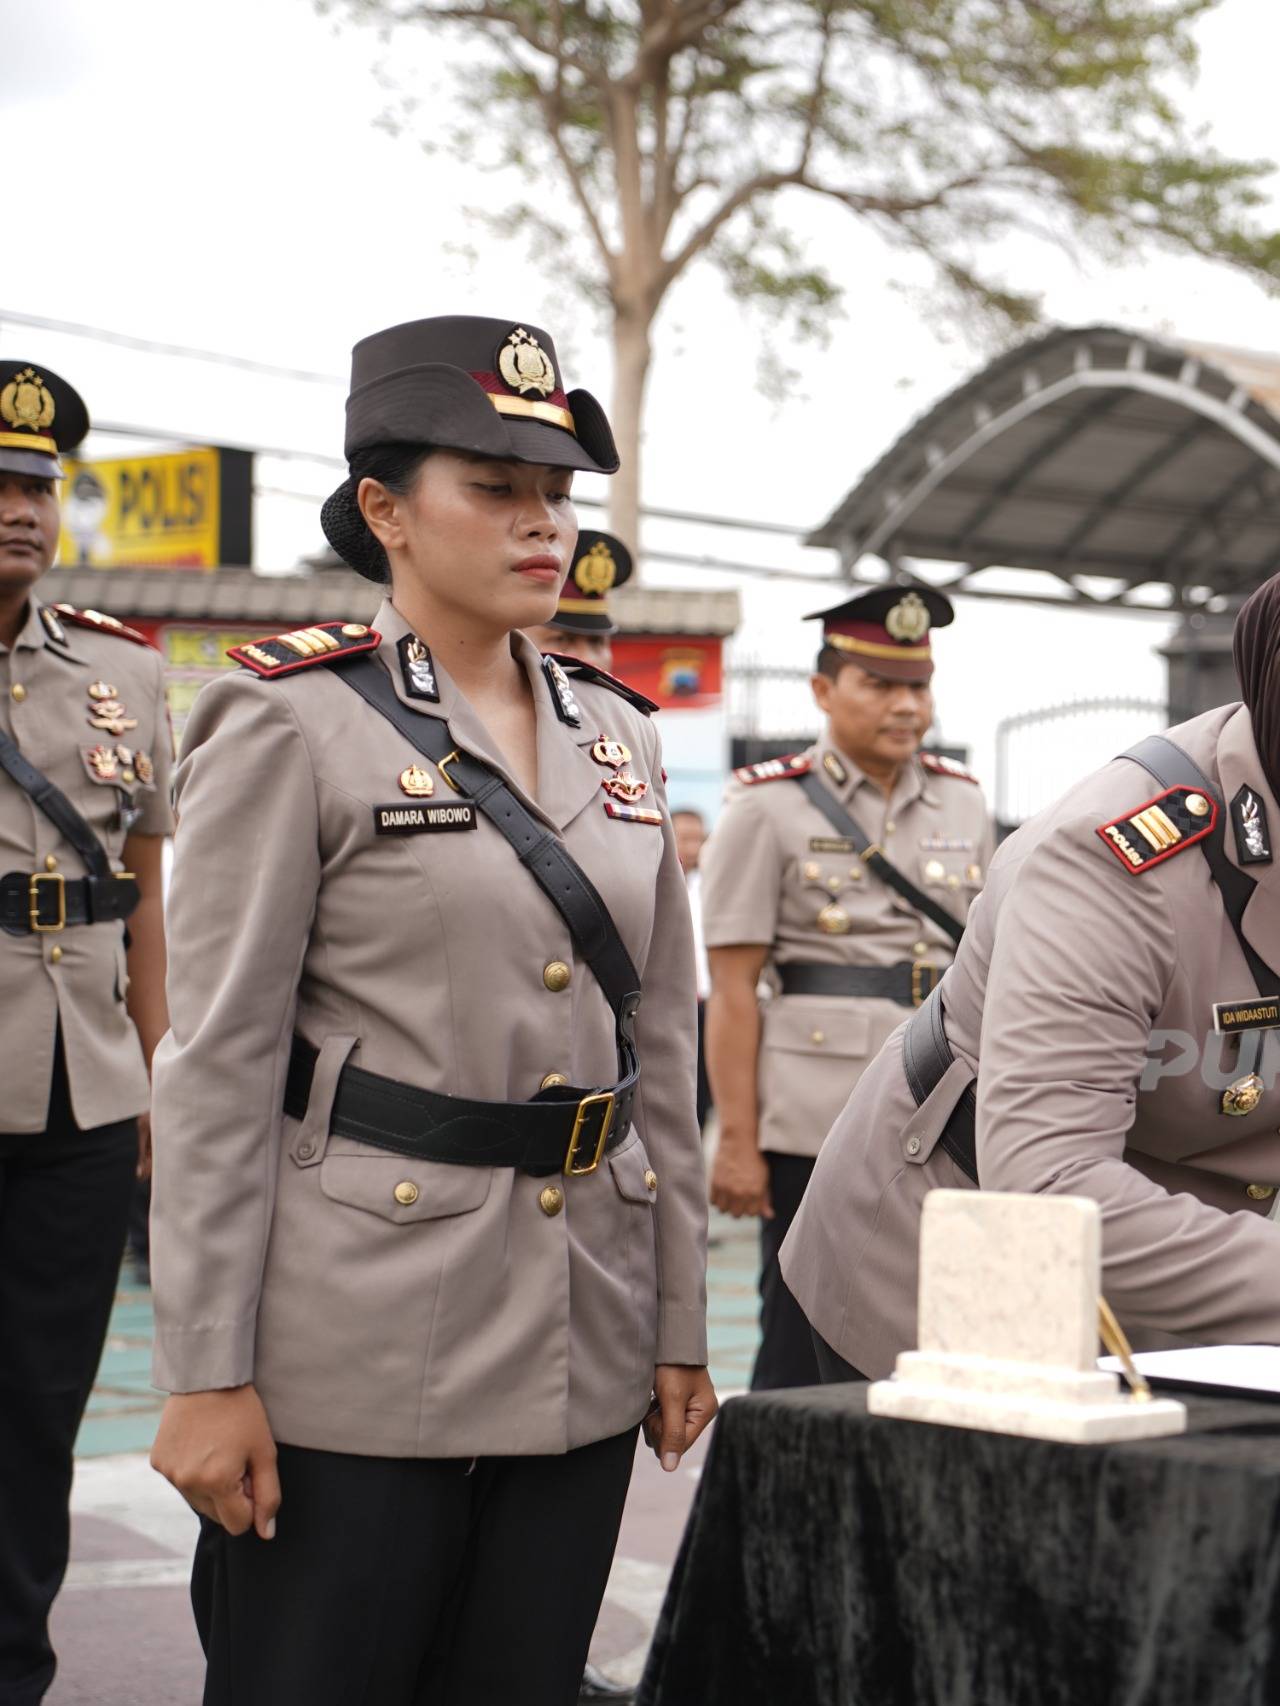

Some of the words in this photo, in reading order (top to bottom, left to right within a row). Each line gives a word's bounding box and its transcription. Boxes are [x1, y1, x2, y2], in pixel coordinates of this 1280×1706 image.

[381, 810, 425, 826] DAMARA
[427, 807, 471, 823] WIBOWO
[1104, 825, 1144, 866] POLISI
[1223, 1011, 1235, 1024] IDA
